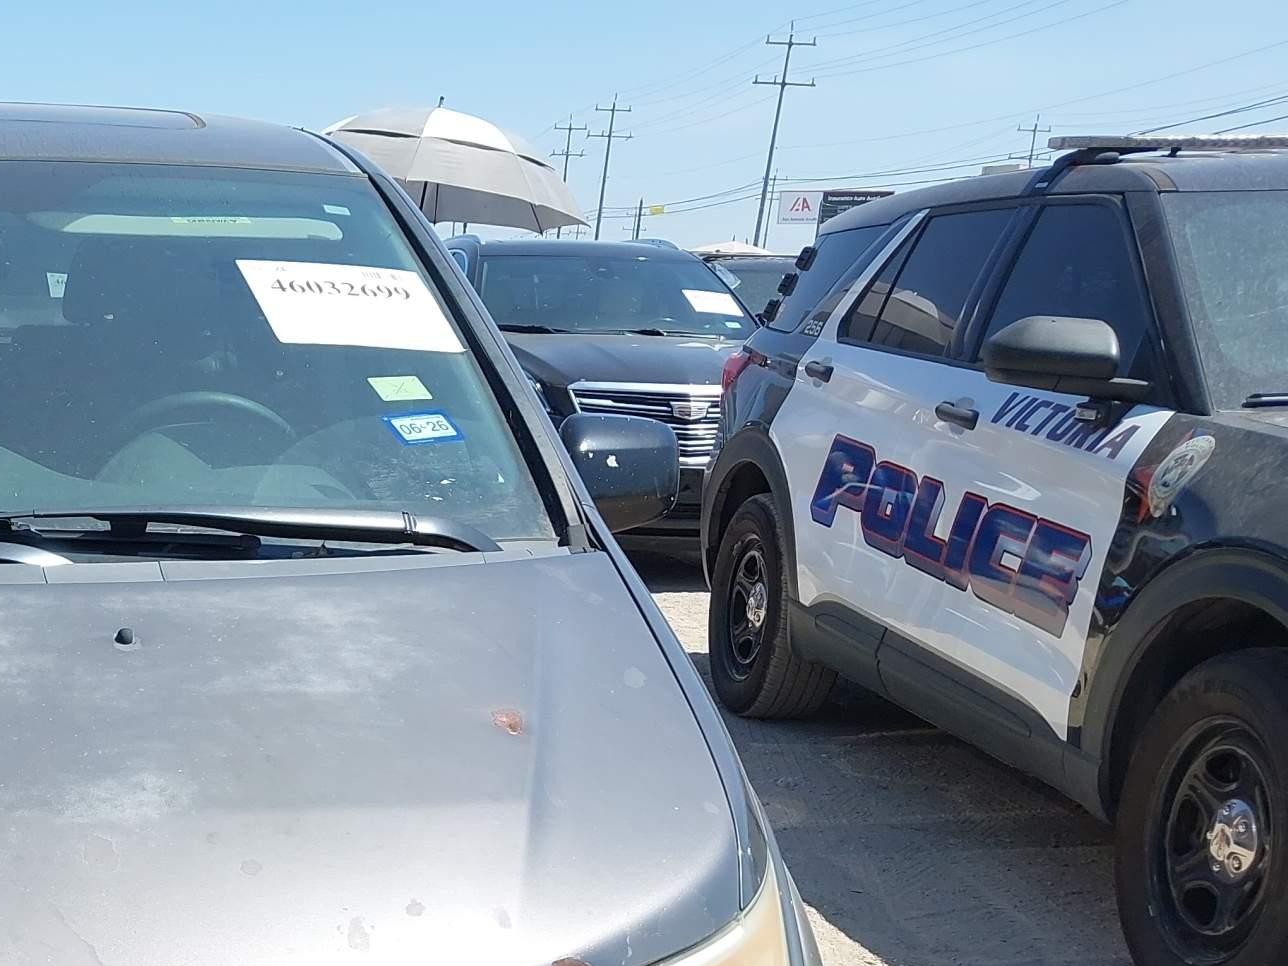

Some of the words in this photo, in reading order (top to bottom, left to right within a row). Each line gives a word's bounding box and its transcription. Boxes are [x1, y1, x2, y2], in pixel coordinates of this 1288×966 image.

[269, 278, 411, 300] 46032699
[399, 423, 422, 435] 06
[426, 420, 449, 432] 26
[810, 433, 1093, 640] POLICE
